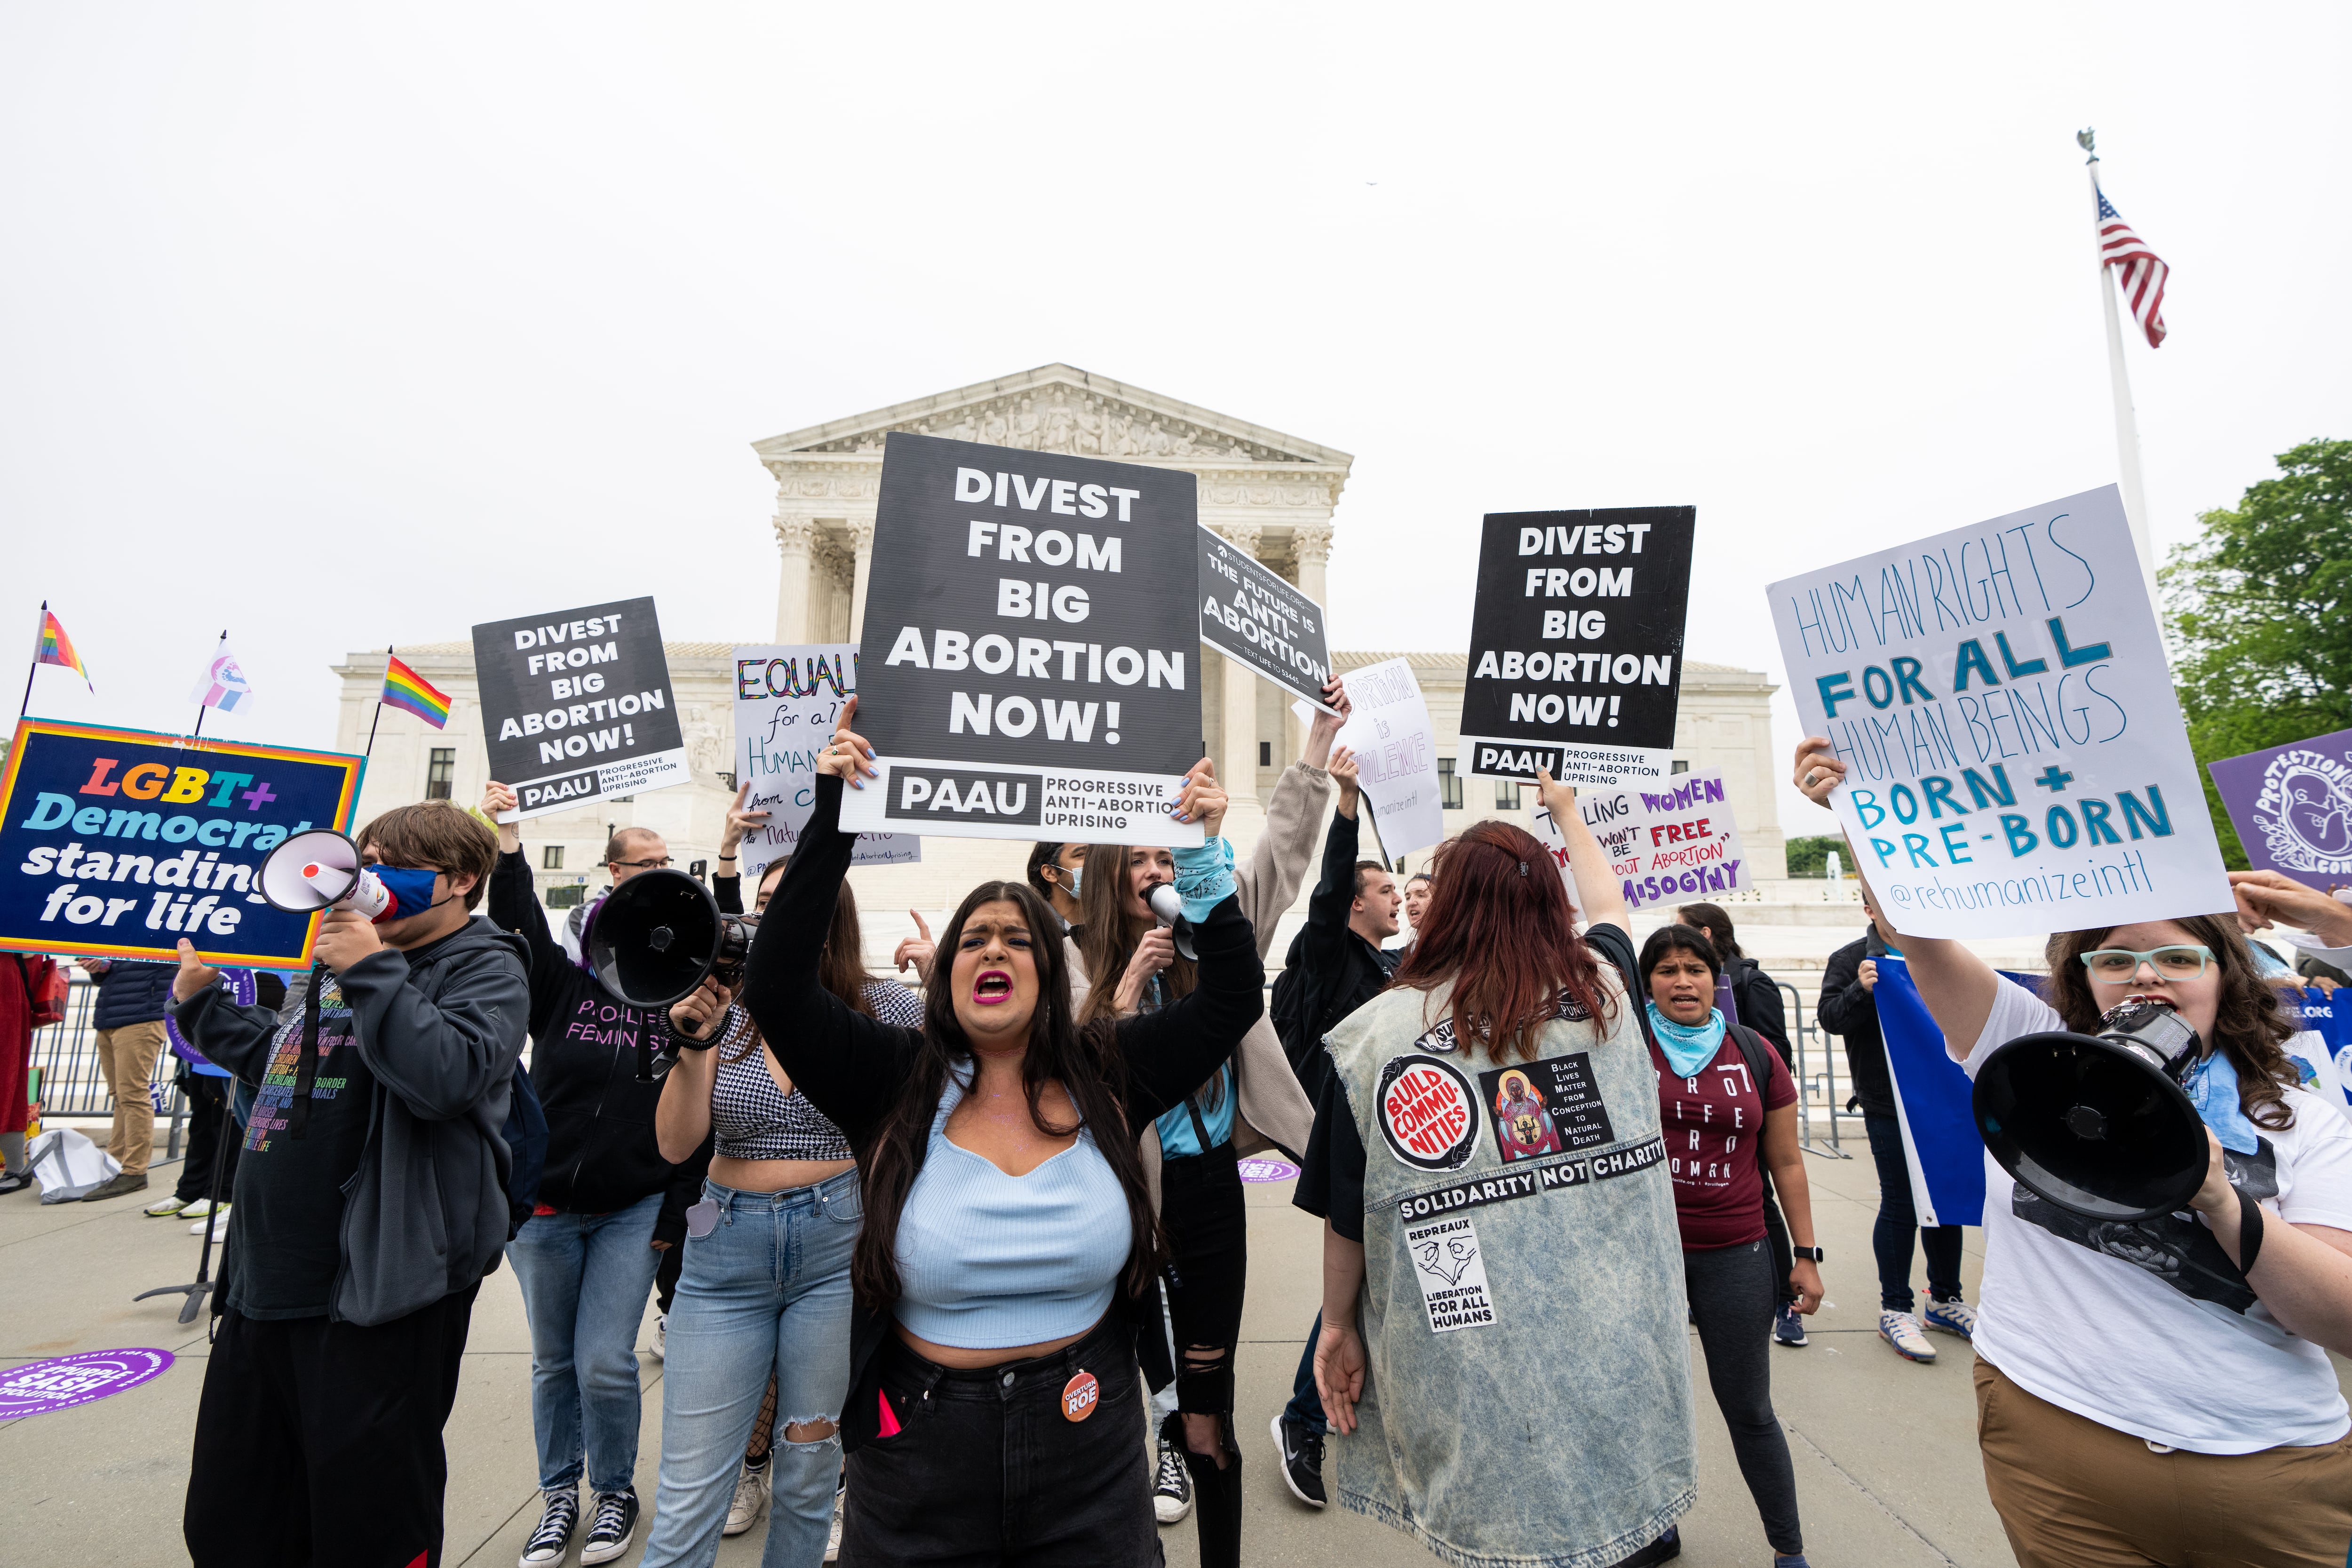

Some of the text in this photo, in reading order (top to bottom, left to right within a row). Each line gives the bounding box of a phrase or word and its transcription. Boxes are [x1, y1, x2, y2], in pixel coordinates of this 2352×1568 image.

[955, 467, 1140, 522] DIVEST
[968, 520, 1121, 573] FROM
[1518, 524, 1651, 556] DIVEST
[1208, 553, 1315, 634] THE FUTURE IS
[1526, 567, 1633, 597] FROM
[1791, 514, 2094, 657] HUMAN RIGHTS
[997, 578, 1089, 623] BIG
[1233, 589, 1298, 640] ANTI-
[515, 614, 621, 650] DIVEST
[1203, 595, 1327, 687] ABORTION
[1542, 610, 1605, 639] BIG
[528, 642, 618, 676] FROM
[884, 626, 1185, 690] ABORTION
[1244, 647, 1300, 685] TEXT LIFE TO 53445
[1474, 651, 1672, 685] ABORTION
[1815, 615, 2114, 719] FOR ALL
[551, 673, 605, 700] BIG
[738, 653, 860, 700] EQUAL
[499, 689, 665, 741] ABORTION
[764, 705, 799, 744] for
[949, 692, 1120, 745] NOW!
[1509, 693, 1621, 727] NOW!
[1827, 707, 1960, 784] HUMAN
[1958, 665, 2126, 764] BEINGS
[539, 723, 635, 764] NOW!
[1374, 718, 1391, 739] is
[599, 757, 664, 776] PROGRESSIVE
[1480, 748, 1554, 773] PAAU
[1565, 761, 1659, 777] ANTI-ABORTION
[1566, 749, 1645, 764] PROGRESSIVE
[79, 758, 277, 811] LGBT+
[524, 776, 592, 806] PAAU
[601, 763, 677, 785] ANTI-ABORTION
[603, 778, 647, 793] UPRISING
[1047, 778, 1164, 797] PROGRESSIVE
[1564, 772, 1618, 785] UPRISING
[2255, 750, 2352, 816] PROTECTION
[747, 793, 783, 812] from
[901, 776, 1027, 815] PAAU
[1045, 796, 1173, 814] ANTI-ABORTIO
[1640, 778, 1724, 813] WOMEN
[1850, 762, 2075, 832] BORN +
[744, 828, 757, 845] to
[1045, 813, 1128, 829] UPRISING
[1650, 818, 1713, 847] FREE
[1869, 783, 2175, 870] PRE-BORN
[1612, 844, 1631, 857] BE
[1891, 850, 2153, 910] @rehumanizeintl
[40, 884, 241, 935] for life
[315, 1077, 347, 1089] BORDER
[1387, 1070, 1441, 1118] BUILD
[270, 1119, 288, 1130] LIVES
[1409, 1105, 1466, 1154] NITIES
[257, 1140, 272, 1152] LIFE
[1401, 1140, 1663, 1218] SOLIDARITY NOT CHARITY
[1409, 1219, 1470, 1242] REPREAUX
[1426, 1285, 1483, 1302] LIBERATION
[1430, 1296, 1489, 1315] FOR ALL
[1432, 1310, 1492, 1329] HUMANS
[2, 1361, 55, 1377] EQUAL
[61, 1351, 116, 1363] RIGHTS
[117, 1367, 159, 1387] WOMEN
[4, 1373, 114, 1393] SASH
[1065, 1379, 1096, 1401] OVERTURN
[1068, 1386, 1096, 1415] ROE
